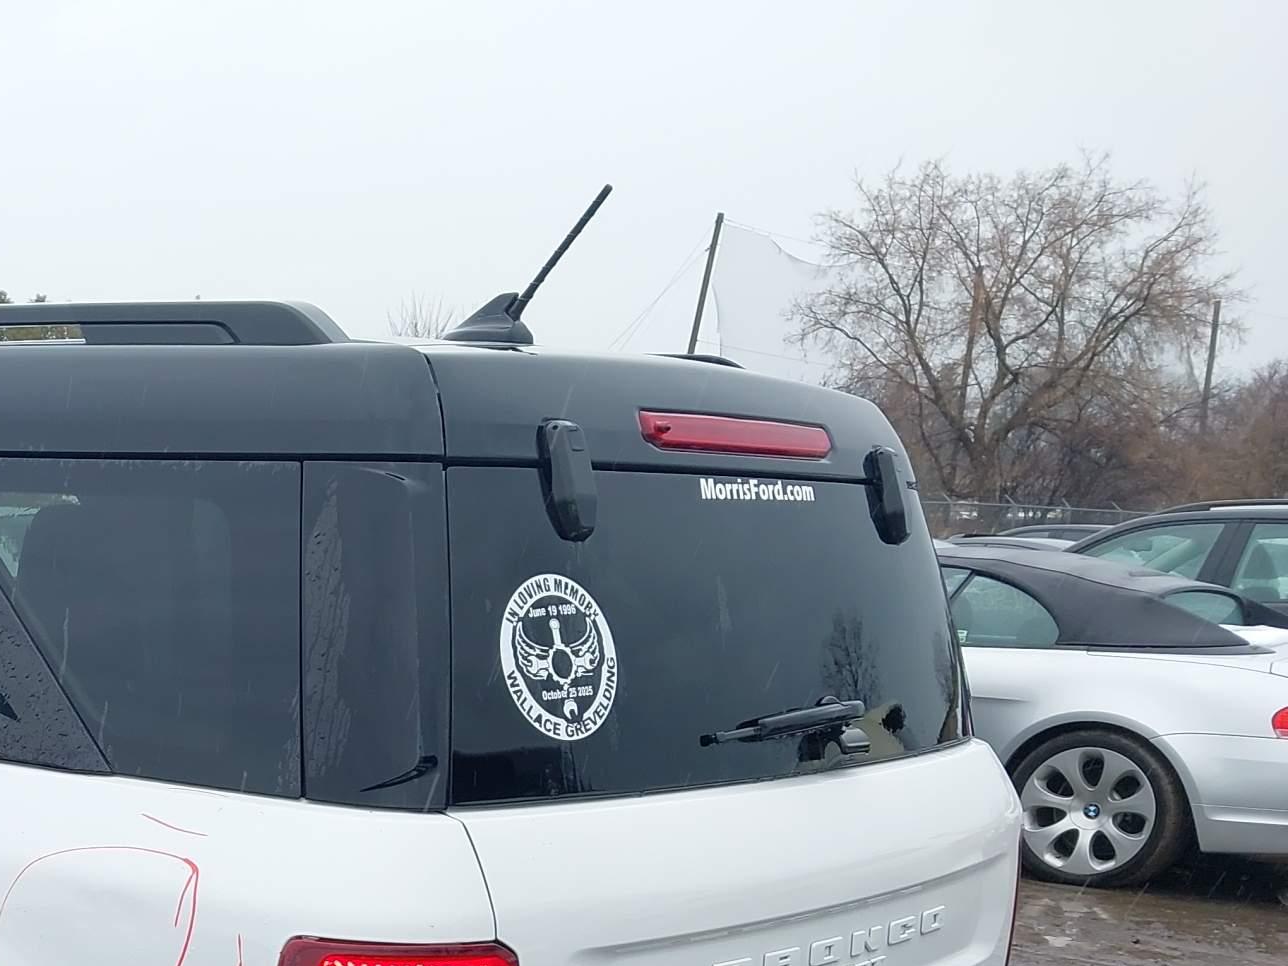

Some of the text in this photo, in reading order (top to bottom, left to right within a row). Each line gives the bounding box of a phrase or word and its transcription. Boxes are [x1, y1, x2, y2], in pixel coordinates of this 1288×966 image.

[699, 478, 815, 501] MorrisFord.com
[505, 577, 600, 624] IN LOVING MEMORY
[528, 603, 577, 618] June 19 1996
[506, 656, 616, 738] WALLACE GREVELDING
[541, 685, 593, 701] October 25 2025
